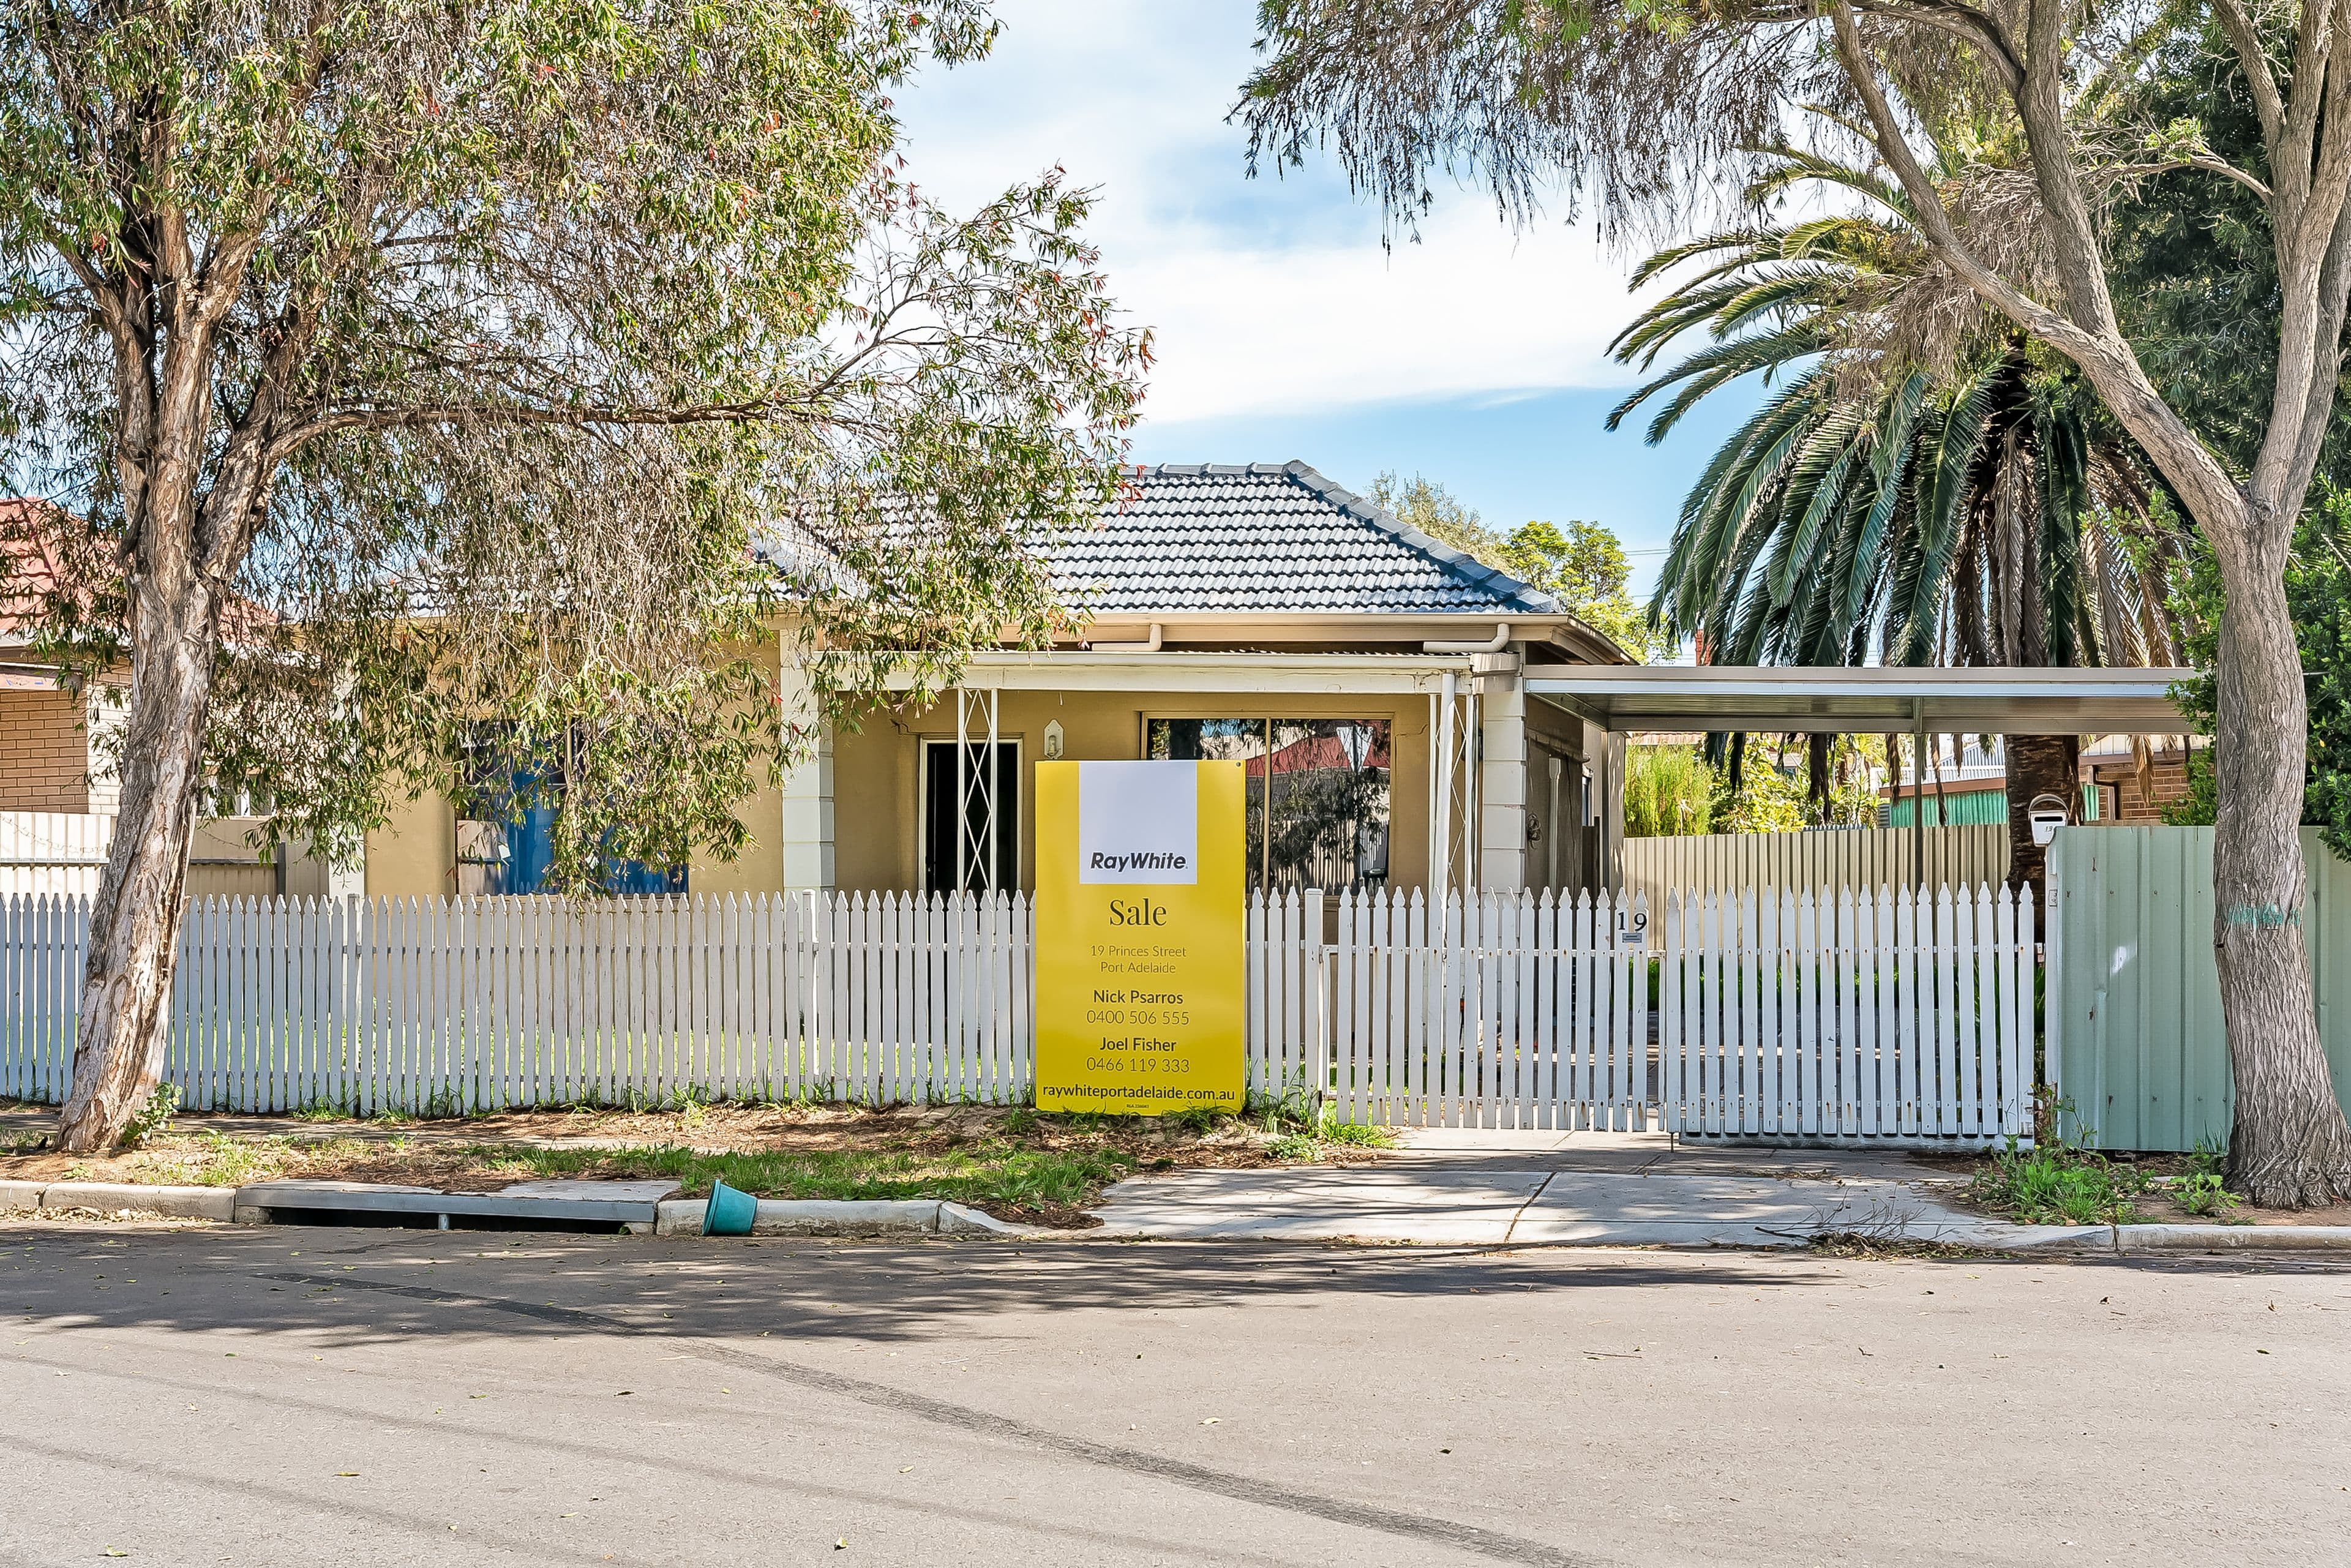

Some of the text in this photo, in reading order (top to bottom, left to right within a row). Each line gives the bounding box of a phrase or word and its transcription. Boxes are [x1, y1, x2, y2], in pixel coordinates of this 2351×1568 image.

[1090, 852, 1187, 872] RayWhite
[1109, 898, 1166, 926] Sale
[1618, 912, 1648, 931] 19
[1091, 945, 1186, 957] 19 Princes Street
[1101, 962, 1176, 973] Port Adelaide
[1093, 990, 1183, 1004] Nick Psarros
[1087, 1010, 1190, 1025] 0400 506 555
[1100, 1037, 1177, 1052] Joel Fisher
[1087, 1057, 1190, 1073] 0466 119 333
[1043, 1085, 1235, 1100] raywhiteportadelaide.com.au
